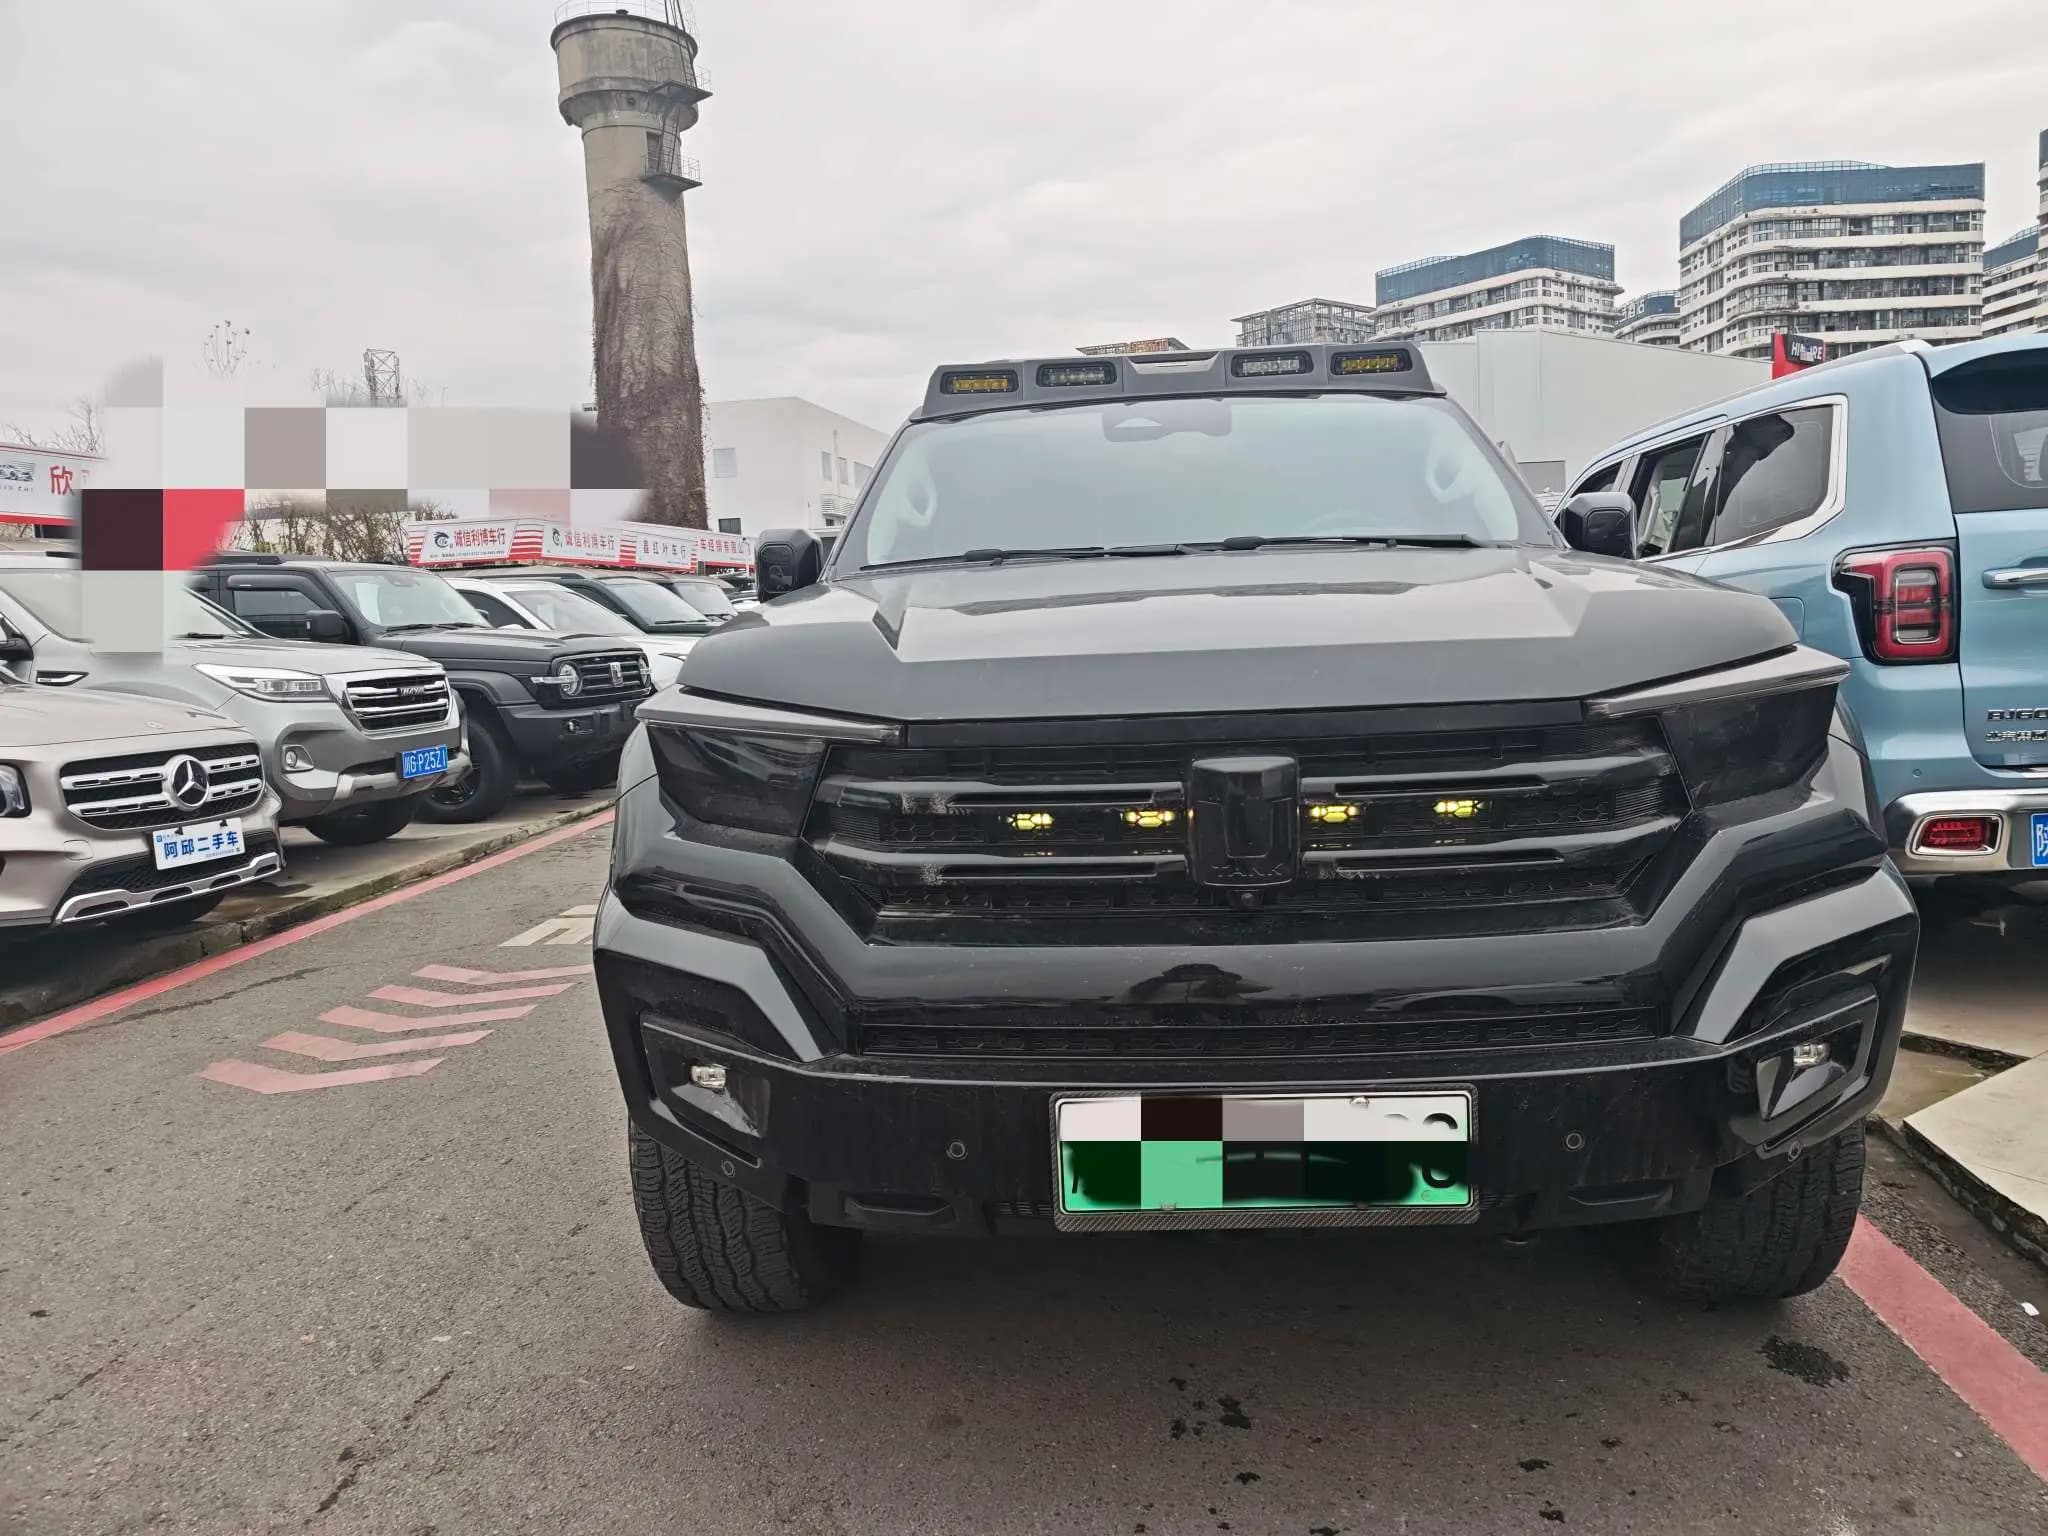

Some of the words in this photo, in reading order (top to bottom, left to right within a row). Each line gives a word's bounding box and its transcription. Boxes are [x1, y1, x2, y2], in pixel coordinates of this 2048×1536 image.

[453, 527, 506, 548] 诚信利博车行
[163, 831, 239, 860] 阿邱二手车
